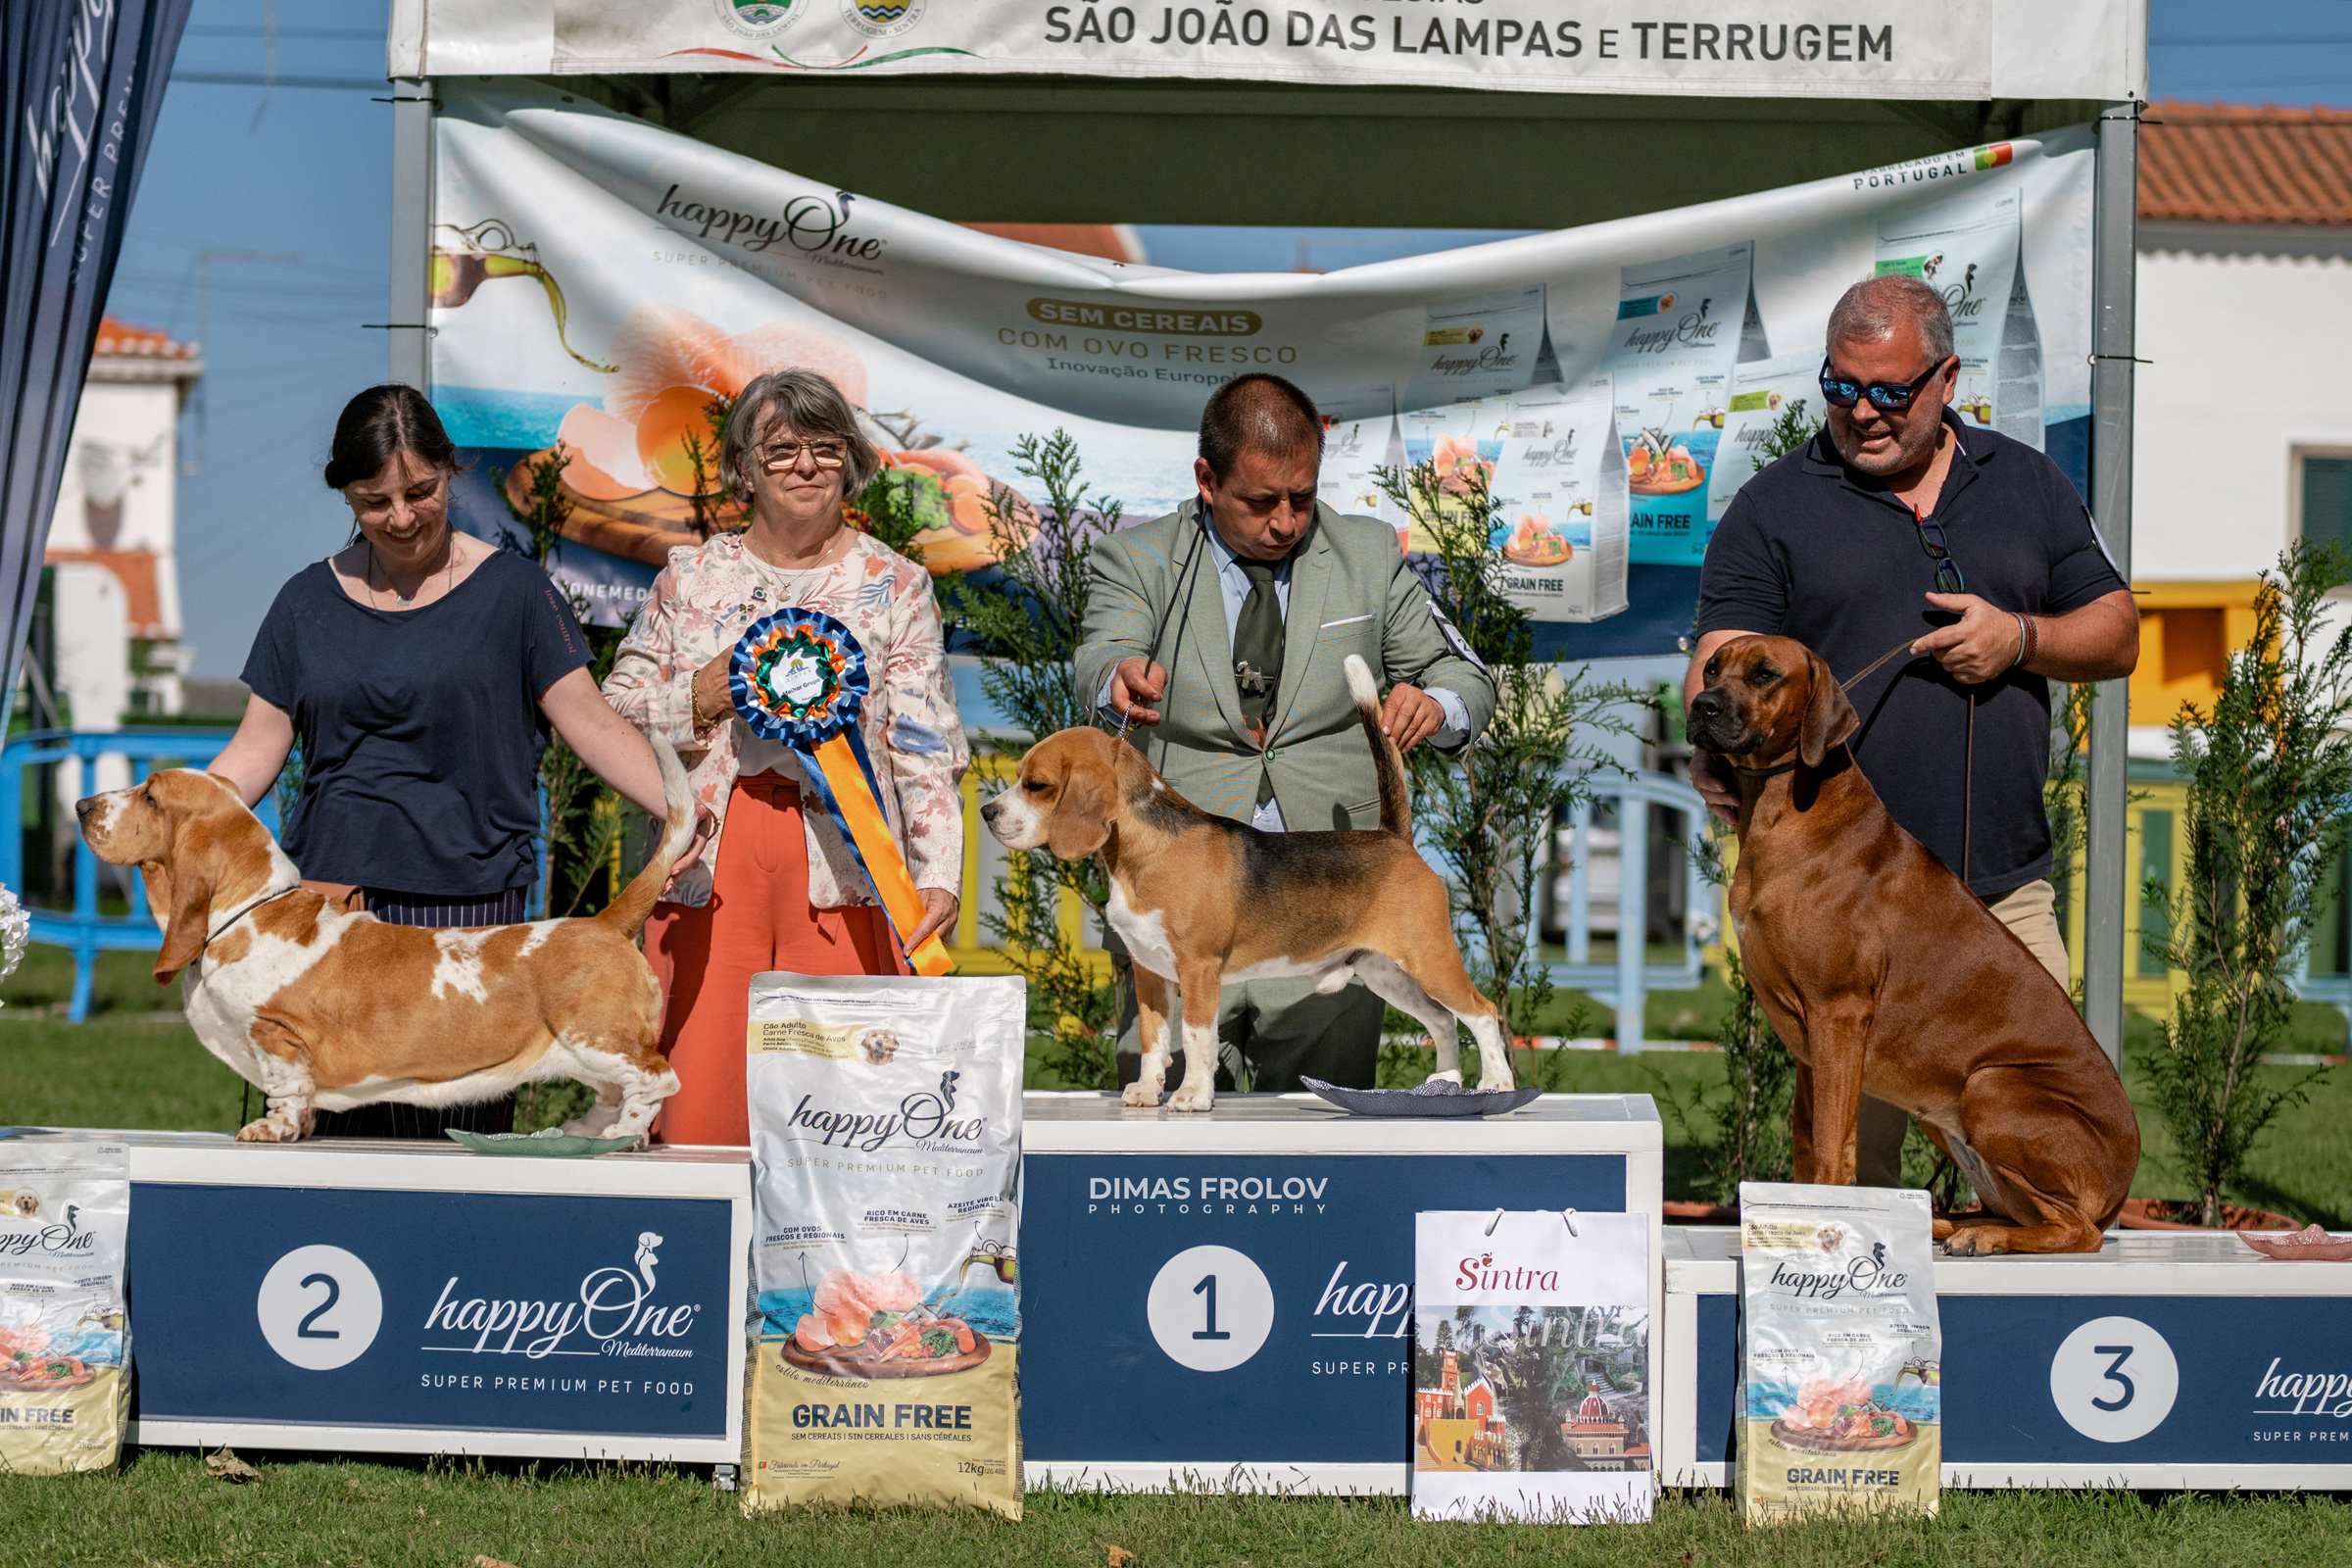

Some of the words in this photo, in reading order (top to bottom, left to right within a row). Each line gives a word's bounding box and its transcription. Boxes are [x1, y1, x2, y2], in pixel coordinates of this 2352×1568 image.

[844, 8, 888, 36] TERRUGEM
[893, 8, 923, 36] SINTRA
[1045, 0, 1136, 43] SÃO
[1150, 0, 1269, 46] JOÃO
[1285, 11, 1376, 51] DAS
[1392, 16, 1583, 57] LAMPAS
[1598, 29, 1619, 59] E
[1631, 23, 1893, 63] TERRUGEM
[1853, 163, 1968, 190] PORTUGAL
[656, 183, 883, 261] happyOne
[653, 251, 709, 267] SUPER
[717, 259, 797, 281] PREMIUM
[806, 274, 834, 289] PET
[1039, 302, 1104, 326] SEM
[1113, 312, 1250, 333] CEREAIS
[1625, 312, 1718, 353] happyOne
[998, 327, 1069, 351] COM
[1083, 337, 1149, 359] OVO
[1164, 343, 1298, 364] FRESCO
[1047, 357, 1149, 379] Inovação
[1629, 513, 1654, 528] AIN
[1657, 514, 1690, 528] FREE
[568, 581, 648, 603] ONEMED
[1506, 576, 1537, 591] GRAIN
[1538, 578, 1564, 592] FREE
[545, 589, 560, 612] lose
[556, 613, 577, 654] control
[788, 1028, 814, 1038] Fresca
[787, 1092, 984, 1152] happyOne
[915, 1138, 984, 1154] Mediterraneum
[787, 1156, 830, 1169] SUPER
[837, 1160, 906, 1173] PREMIUM
[913, 1164, 939, 1176] PET
[946, 1167, 984, 1178] FOOD
[901, 1210, 928, 1219] CARNE
[947, 1200, 975, 1208] AZEITE
[957, 1201, 996, 1213] REGIONAL
[765, 1233, 795, 1243] FRESCOS
[1455, 1251, 1561, 1293] Sintra
[1770, 1255, 1907, 1300] happyOne
[297, 1272, 341, 1340] 2
[423, 1265, 695, 1360] happyOne
[1192, 1274, 1232, 1341] 1
[1770, 1303, 1801, 1314] SUPER
[1806, 1305, 1855, 1315] PREMIUM
[1859, 1306, 1879, 1315] PET
[1883, 1306, 1909, 1315] FOOD
[600, 1339, 695, 1360] Mediterraneum
[775, 1363, 801, 1381] estilo
[802, 1373, 870, 1390] mediterrâneo
[1311, 1361, 1376, 1376] SUPER
[2091, 1345, 2135, 1413] 3
[420, 1374, 484, 1390] SUPER
[494, 1376, 588, 1394] PREMIUM
[597, 1379, 633, 1395] PET
[643, 1381, 695, 1396] FOOD
[24, 1407, 74, 1424] FREE
[792, 1403, 885, 1429] GRAIN
[895, 1403, 972, 1430] FREE
[76, 1441, 93, 1451] 3kg
[791, 1432, 807, 1441] SEM
[808, 1432, 842, 1441] CEREAIS
[847, 1432, 863, 1441] SIN
[864, 1432, 906, 1442] CEREALES
[910, 1432, 932, 1442] SANS
[932, 1431, 972, 1443] CÉRÉALES
[2252, 1431, 2302, 1443] SUPER
[2309, 1431, 2350, 1443] PREM
[808, 1458, 841, 1471] Portugal
[957, 1461, 985, 1477] 12kg
[1787, 1468, 1847, 1485] GRAIN
[1852, 1469, 1900, 1487] FREE
